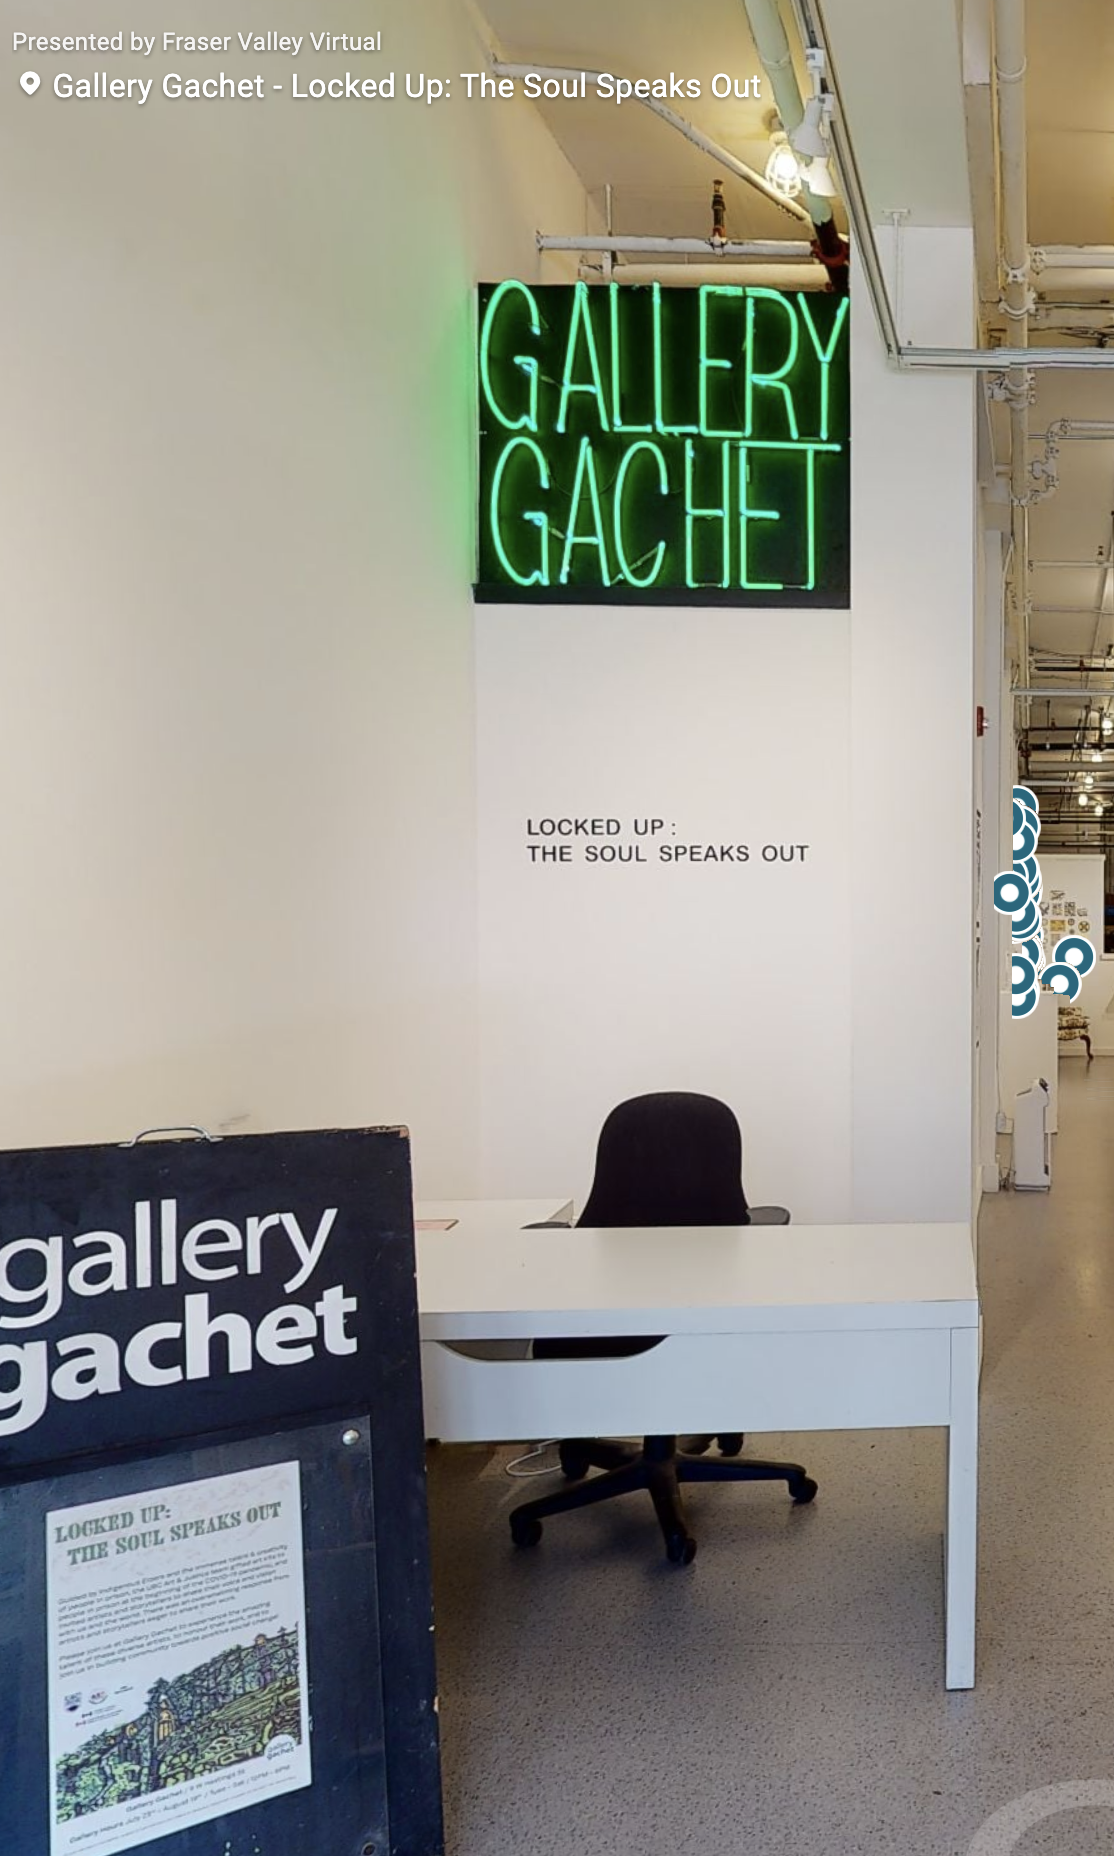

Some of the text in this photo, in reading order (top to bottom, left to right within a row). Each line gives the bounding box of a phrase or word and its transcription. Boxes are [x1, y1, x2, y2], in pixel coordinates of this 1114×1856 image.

[480, 279, 850, 441] GALLERY
[491, 436, 841, 590] GACHET
[527, 819, 621, 836] LOCKED
[527, 845, 810, 862] THE SOUL SPEAKS OUT
[0, 1198, 339, 1330] gallery
[0, 1284, 358, 1437] gachet
[54, 1504, 171, 1544] LOCKED UP:
[66, 1501, 283, 1566] THE SOUL SPEAKS OUT
